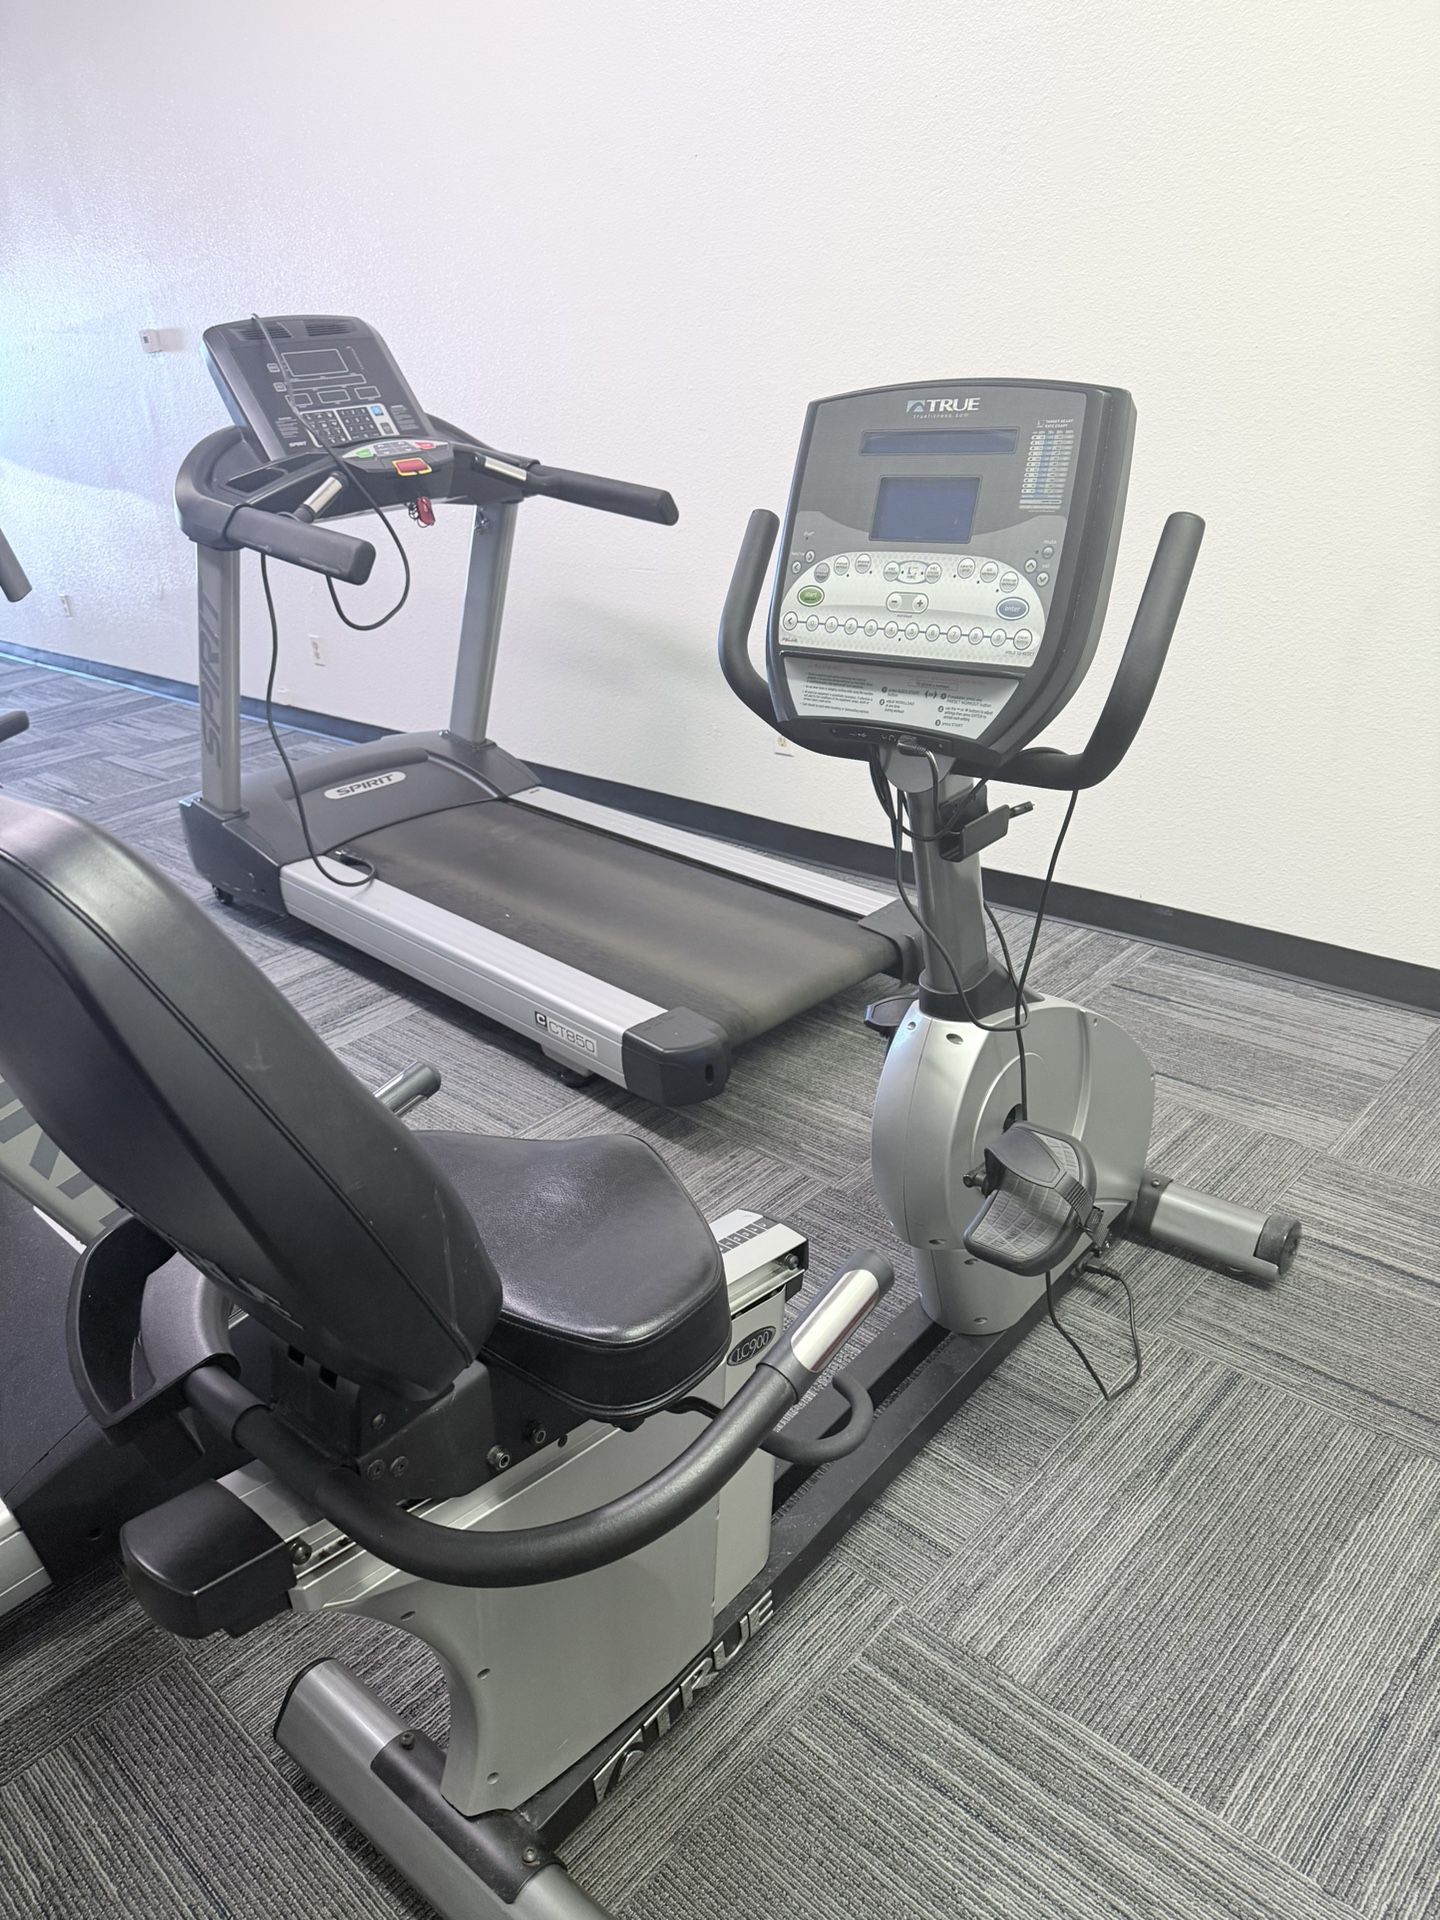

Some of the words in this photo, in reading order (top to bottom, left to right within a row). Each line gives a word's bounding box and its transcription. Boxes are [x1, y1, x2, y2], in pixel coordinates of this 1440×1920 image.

[926, 397, 981, 412] TRUE
[199, 591, 222, 769] SPIRIT
[336, 774, 393, 796] SPIRIT
[548, 1021, 595, 1053] CT850
[735, 1331, 769, 1361] LC900
[643, 1589, 774, 1738] TRUE
